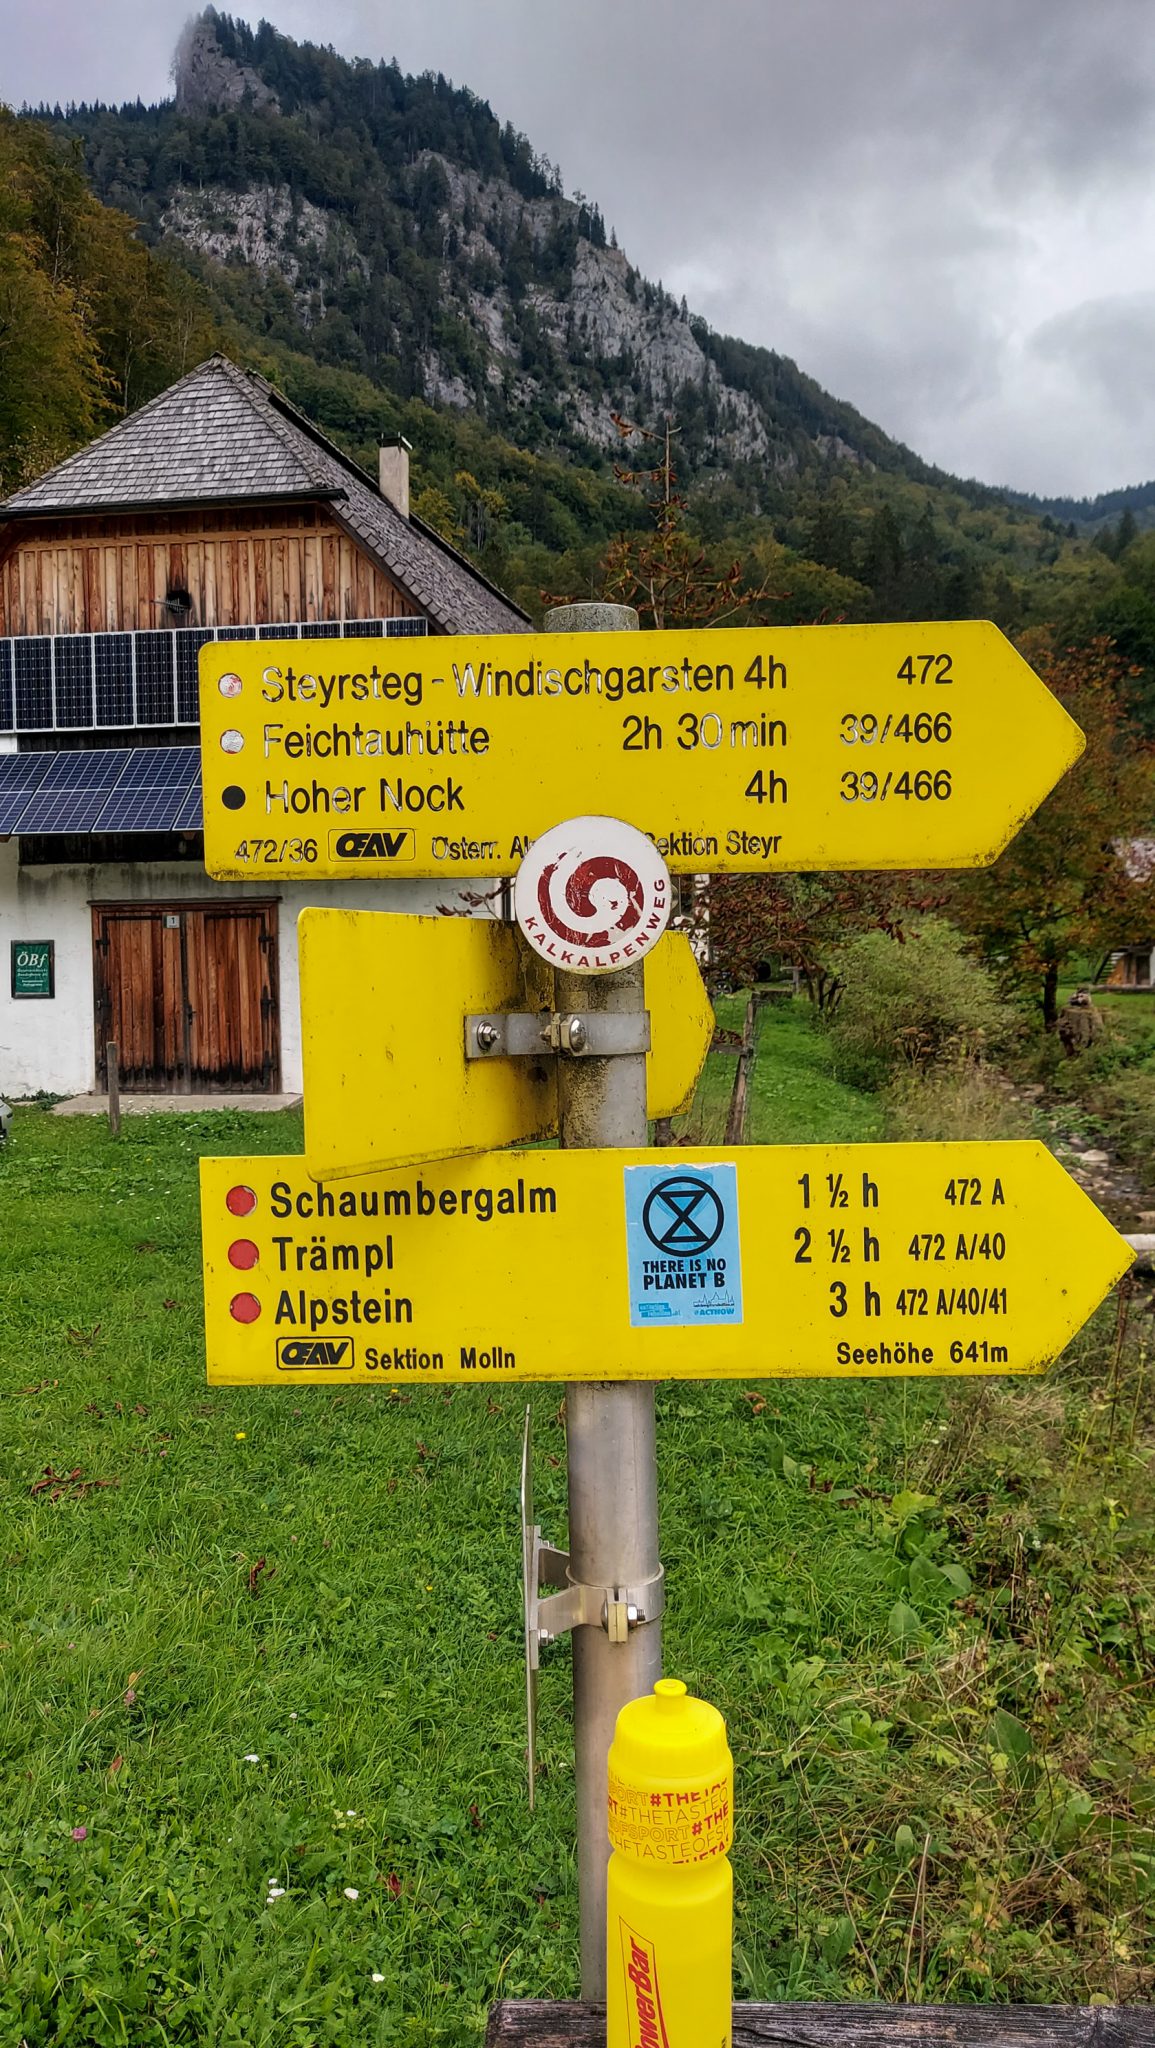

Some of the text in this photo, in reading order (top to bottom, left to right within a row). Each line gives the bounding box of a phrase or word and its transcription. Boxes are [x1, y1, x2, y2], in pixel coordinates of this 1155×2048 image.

[261, 664, 423, 708] Steyrsteg
[452, 658, 735, 702] Windischgarsten
[744, 655, 787, 690] 4h
[897, 653, 953, 685] 472
[264, 711, 953, 758] Feichtauhütte 2h 30 min 39/466
[265, 769, 953, 815] Hoher Nock 4h 39/466
[234, 838, 318, 863] 472/36
[432, 836, 501, 861] Österr.
[726, 830, 782, 859] Steyr
[525, 878, 666, 968] KALKALPENWEG
[17, 951, 48, 968] ÖBf
[270, 1178, 556, 1221] Schaumbergalm
[798, 1173, 811, 1208] 1
[863, 1172, 879, 1207] h
[944, 1178, 982, 1206] 472
[991, 1178, 1006, 1205] A
[272, 1235, 394, 1277] Trämpl
[794, 1227, 812, 1263] 2
[863, 1227, 880, 1262] h
[908, 1234, 945, 1261] 472
[955, 1233, 1006, 1261] A/40
[643, 1258, 726, 1273] THERE IS NO
[643, 1272, 725, 1290] PLANET B
[275, 1281, 1008, 1331] Alpstein 3 h 472 A/40/41
[365, 1347, 443, 1370] Sektion
[460, 1346, 516, 1369] Molln
[836, 1341, 934, 1365] Seehöhe
[949, 1340, 1009, 1364] 641m
[628, 1935, 660, 2048] owerBar
